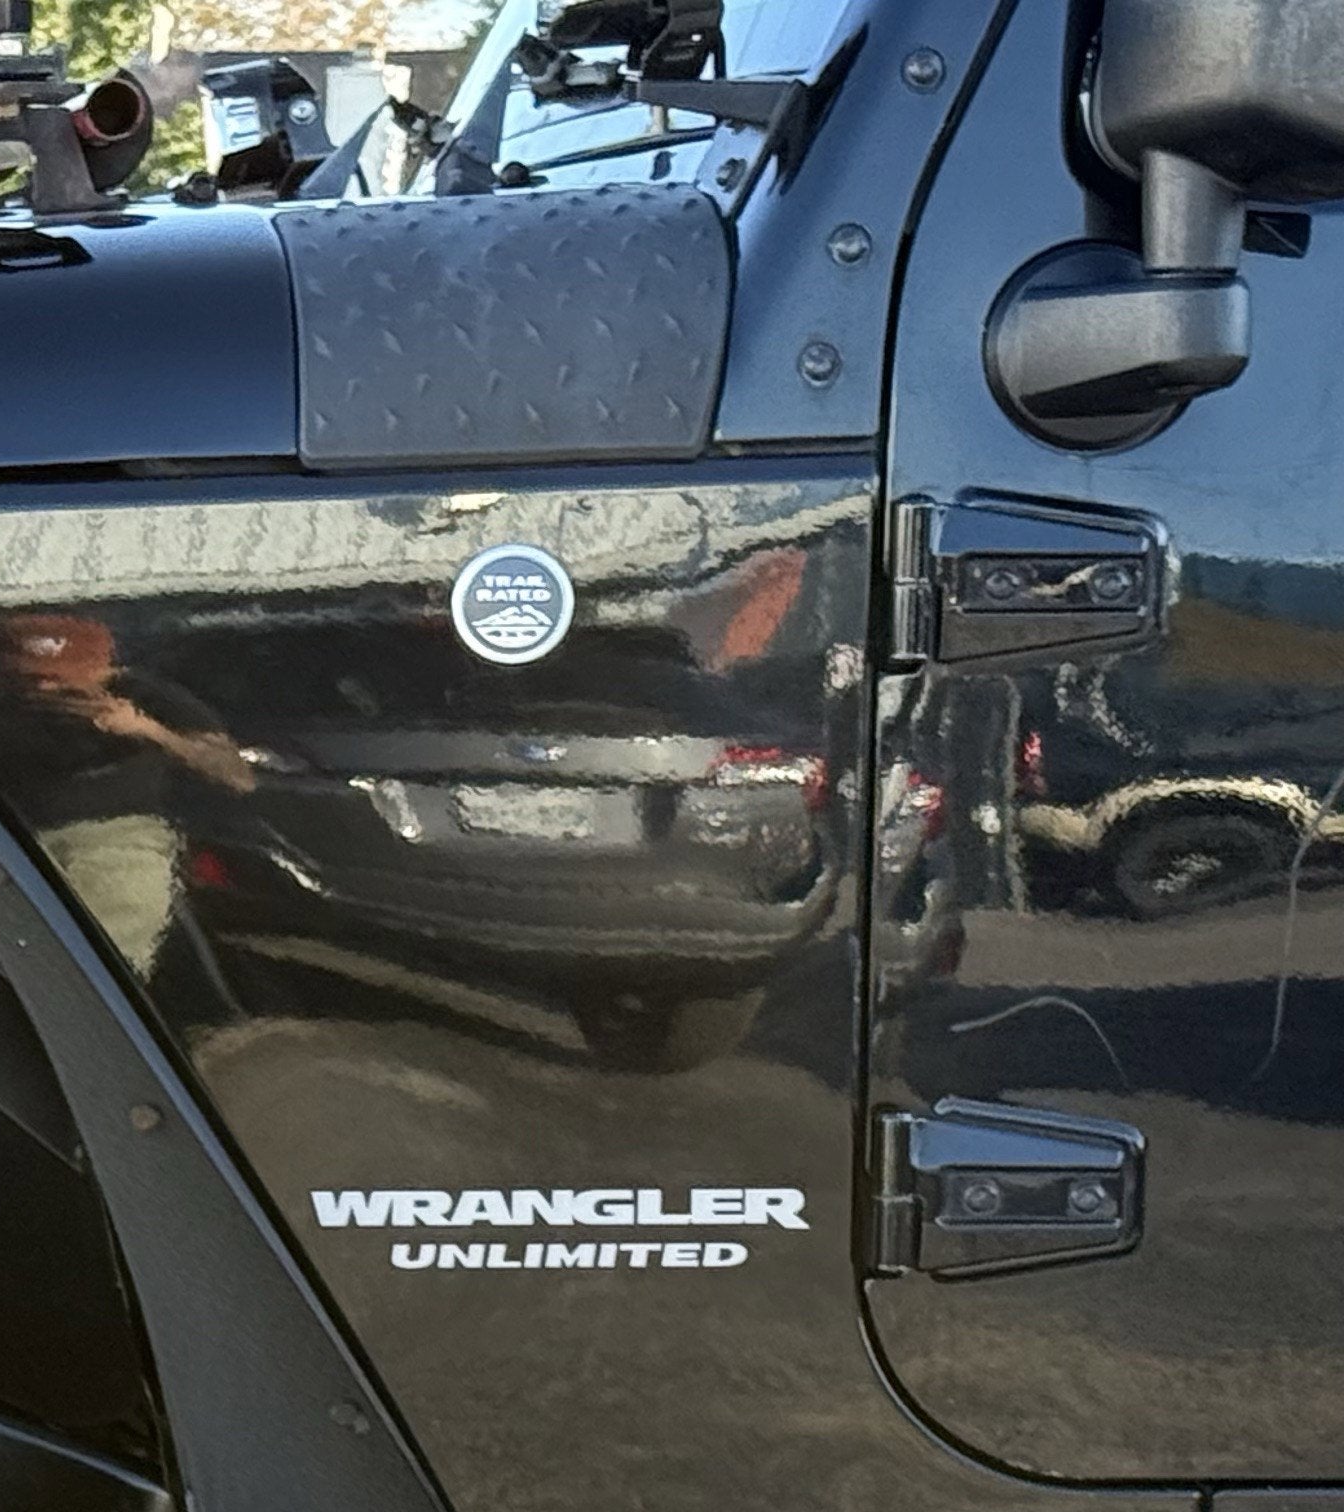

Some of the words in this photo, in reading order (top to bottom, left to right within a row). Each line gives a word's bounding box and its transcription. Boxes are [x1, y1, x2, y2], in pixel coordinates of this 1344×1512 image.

[475, 589, 551, 602] RATED
[311, 1188, 810, 1229] WRANGLER
[391, 1242, 748, 1270] UNLIMITED
